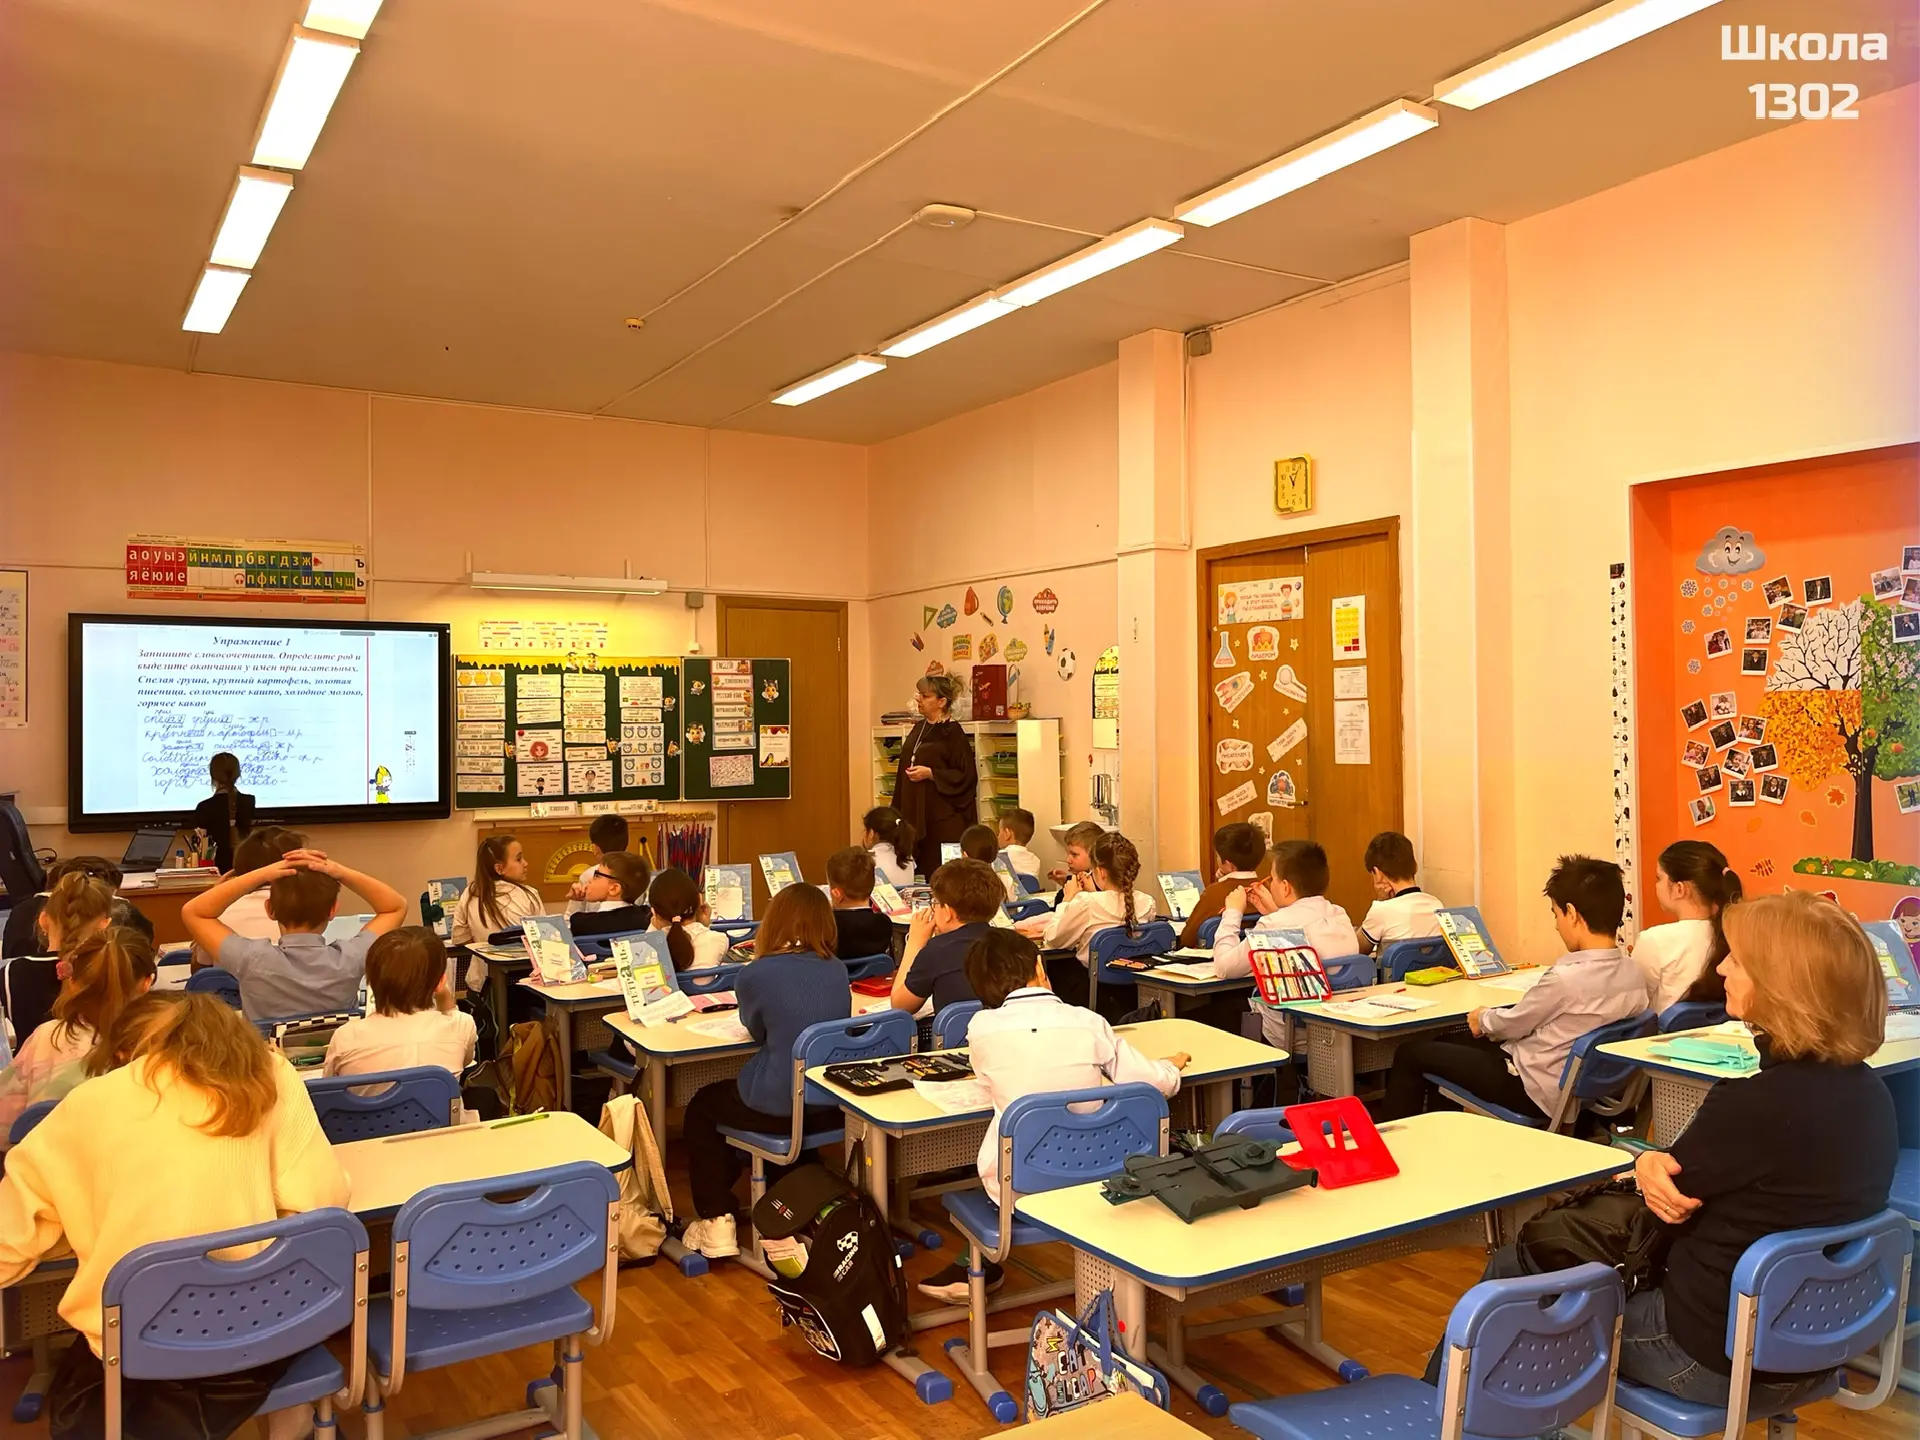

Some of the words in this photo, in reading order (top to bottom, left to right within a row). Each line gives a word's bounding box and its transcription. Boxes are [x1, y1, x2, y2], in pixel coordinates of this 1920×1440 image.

[212, 636, 282, 647] Упражнение
[138, 649, 192, 658] Запишите
[194, 651, 276, 660] словосочетания.
[279, 651, 336, 661] Определите
[337, 653, 354, 662] род
[137, 662, 188, 670] выделите
[190, 663, 242, 671] окончания
[252, 664, 277, 672] имен
[279, 665, 359, 673] прилагательных.
[137, 675, 174, 684] Спелая
[176, 677, 210, 686] груша,
[212, 677, 254, 686] крупный
[256, 677, 312, 686] картофель,
[137, 689, 187, 697] пшеница,
[248, 689, 282, 697] кашпо,
[328, 689, 364, 697] молоко,
[137, 701, 176, 709] горячее
[838, 1245, 859, 1271] RACING
[842, 1260, 854, 1276] CAR
